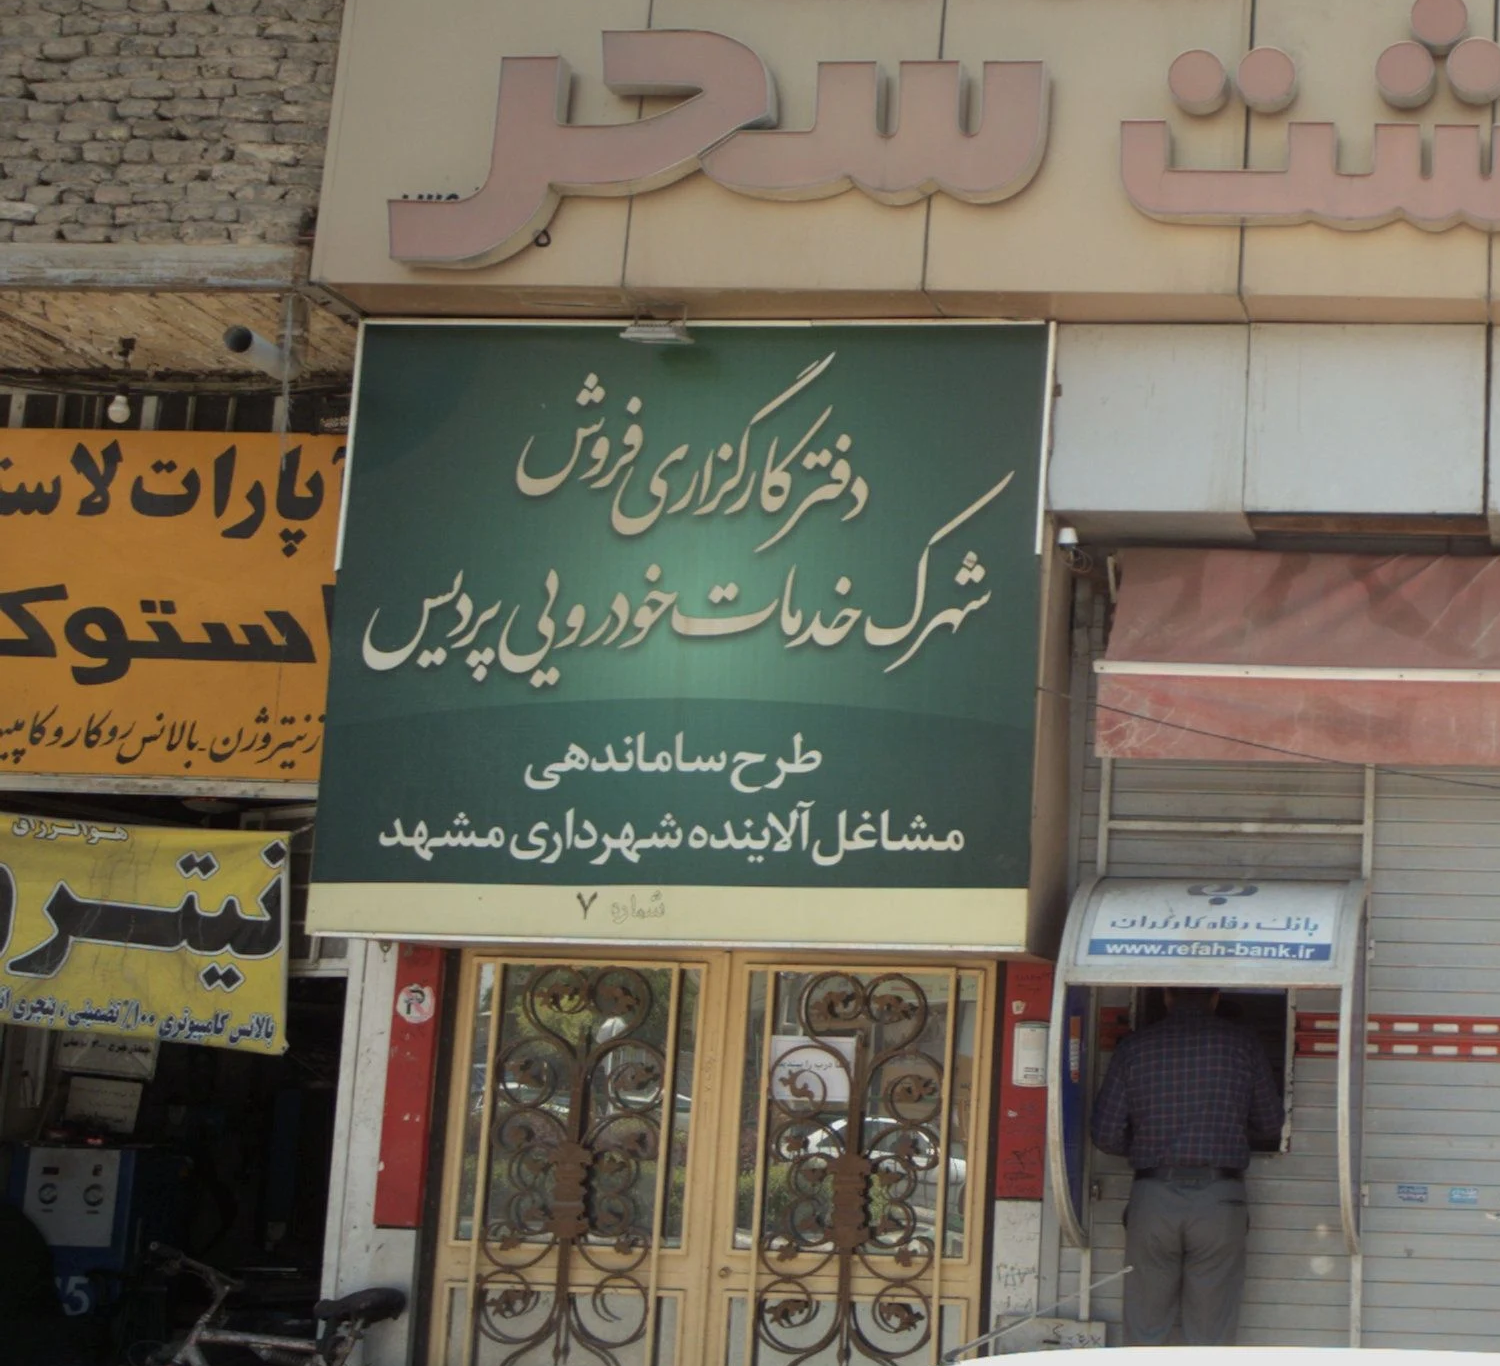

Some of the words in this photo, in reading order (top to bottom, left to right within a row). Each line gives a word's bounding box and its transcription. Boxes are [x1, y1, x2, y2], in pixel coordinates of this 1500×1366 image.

[386, 28, 1053, 270] سحر
[515, 371, 645, 499] فروش
[611, 351, 837, 536] کارگزاری
[755, 433, 870, 553] دفتر
[362, 570, 504, 683] پردیس
[669, 565, 862, 651] خدمات
[524, 732, 728, 791] ساماندهی
[729, 733, 824, 794] طرح
[378, 811, 506, 865] مشهد
[508, 808, 684, 866] شهرداری
[686, 800, 814, 865] آلاینده
[811, 809, 966, 867] مشاغل
[1105, 941, 1316, 960] www.refah-bank.ir
